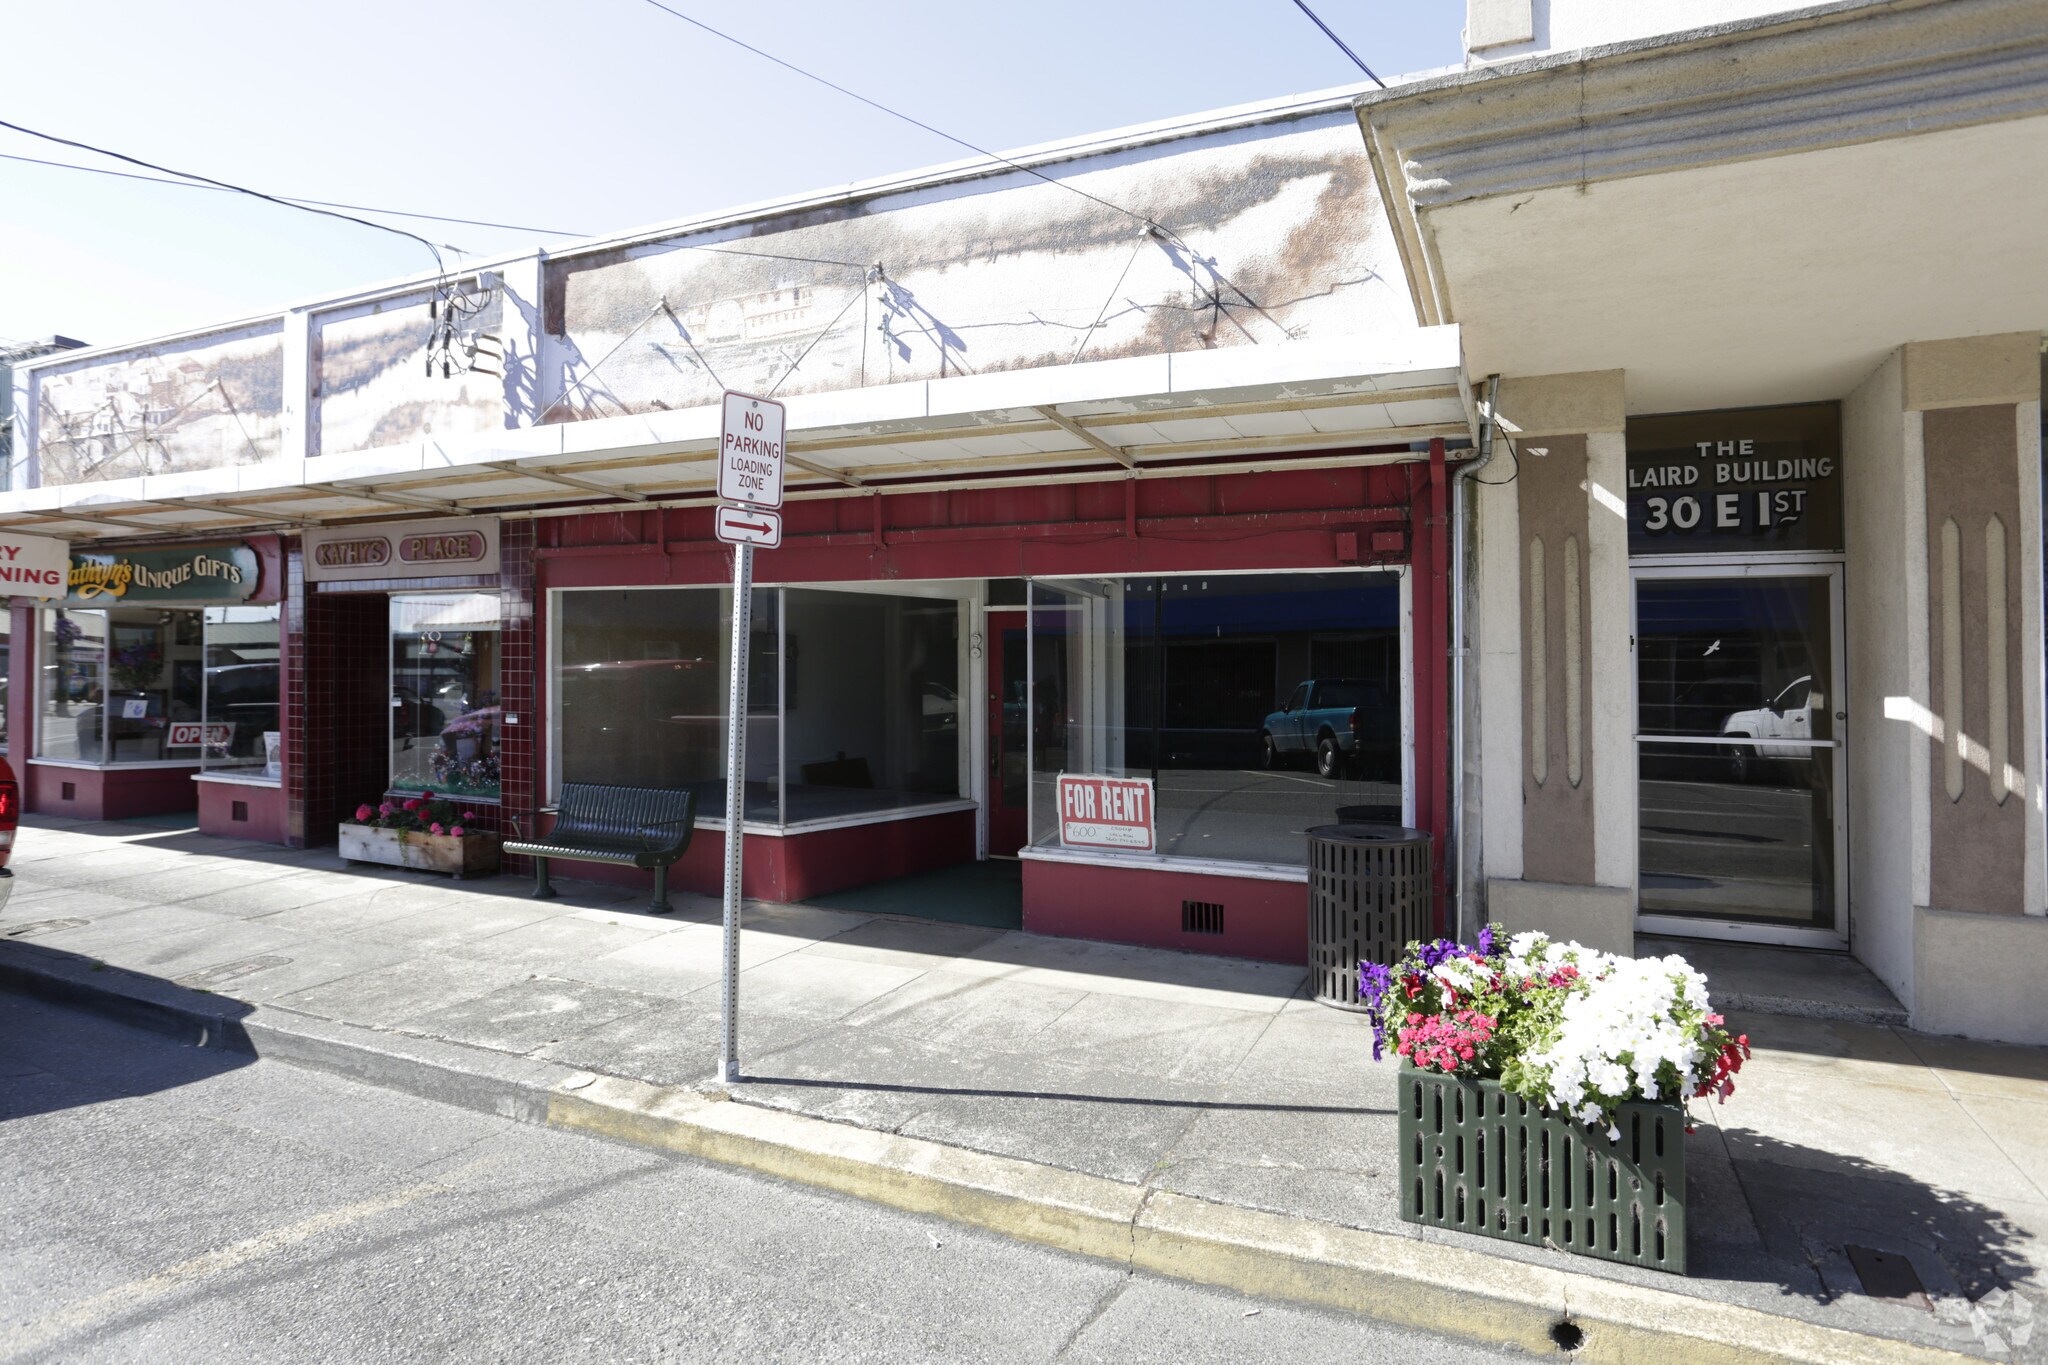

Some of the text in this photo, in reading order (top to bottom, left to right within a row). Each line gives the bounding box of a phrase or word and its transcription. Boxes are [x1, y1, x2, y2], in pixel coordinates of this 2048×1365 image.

[745, 411, 763, 431] NO
[726, 434, 779, 459] PARKING
[1696, 439, 1754, 457] THE
[731, 457, 773, 477] LOADING
[1629, 457, 1834, 488] LAIRD BUILDING
[738, 474, 764, 490] ZONE
[1645, 496, 1701, 530] 30
[1716, 494, 1740, 527] E
[0, 545, 22, 561] Y
[411, 536, 471, 561] PLACE
[68, 558, 132, 599] athryn's
[175, 727, 224, 743] OPEN
[1065, 783, 1145, 822] FOR RENT
